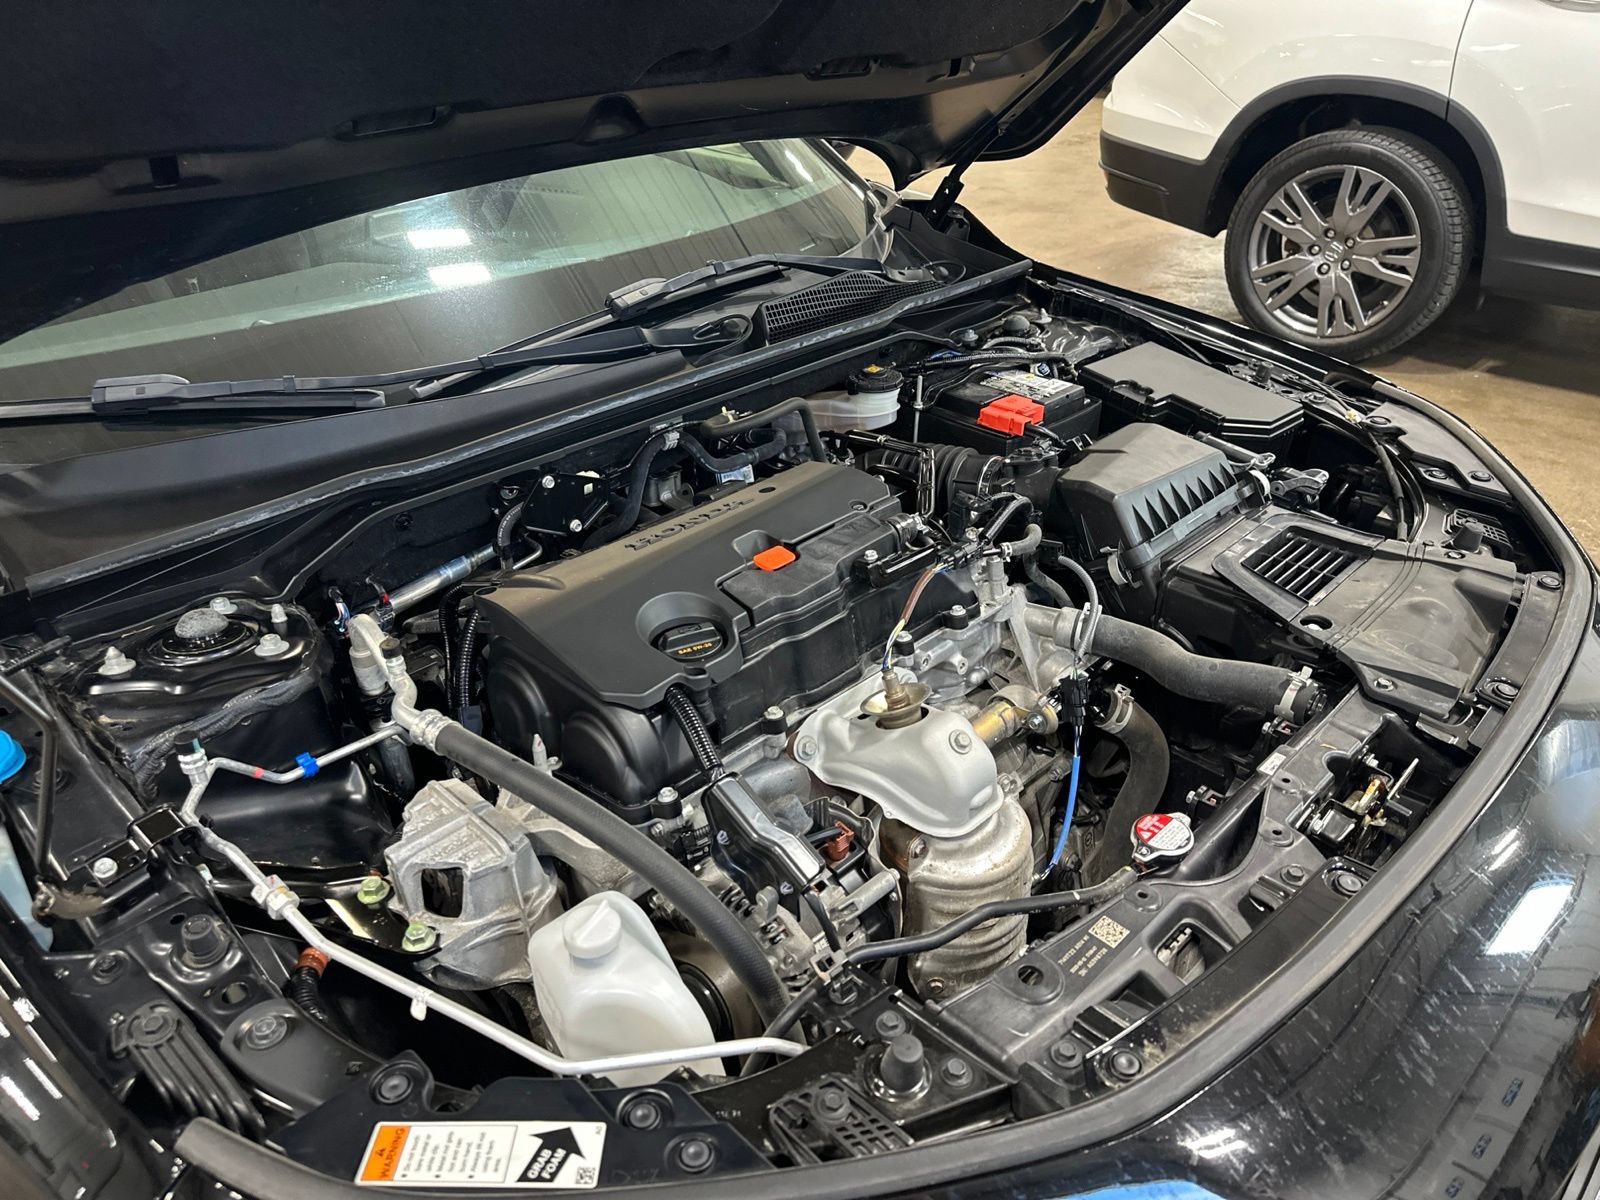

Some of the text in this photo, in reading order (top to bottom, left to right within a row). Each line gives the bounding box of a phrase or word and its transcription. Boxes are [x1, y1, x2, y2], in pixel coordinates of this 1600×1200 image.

[379, 1128, 405, 1178] WARNING
[527, 1148, 552, 1179] GRAB
[541, 1148, 567, 1179] FOAM
